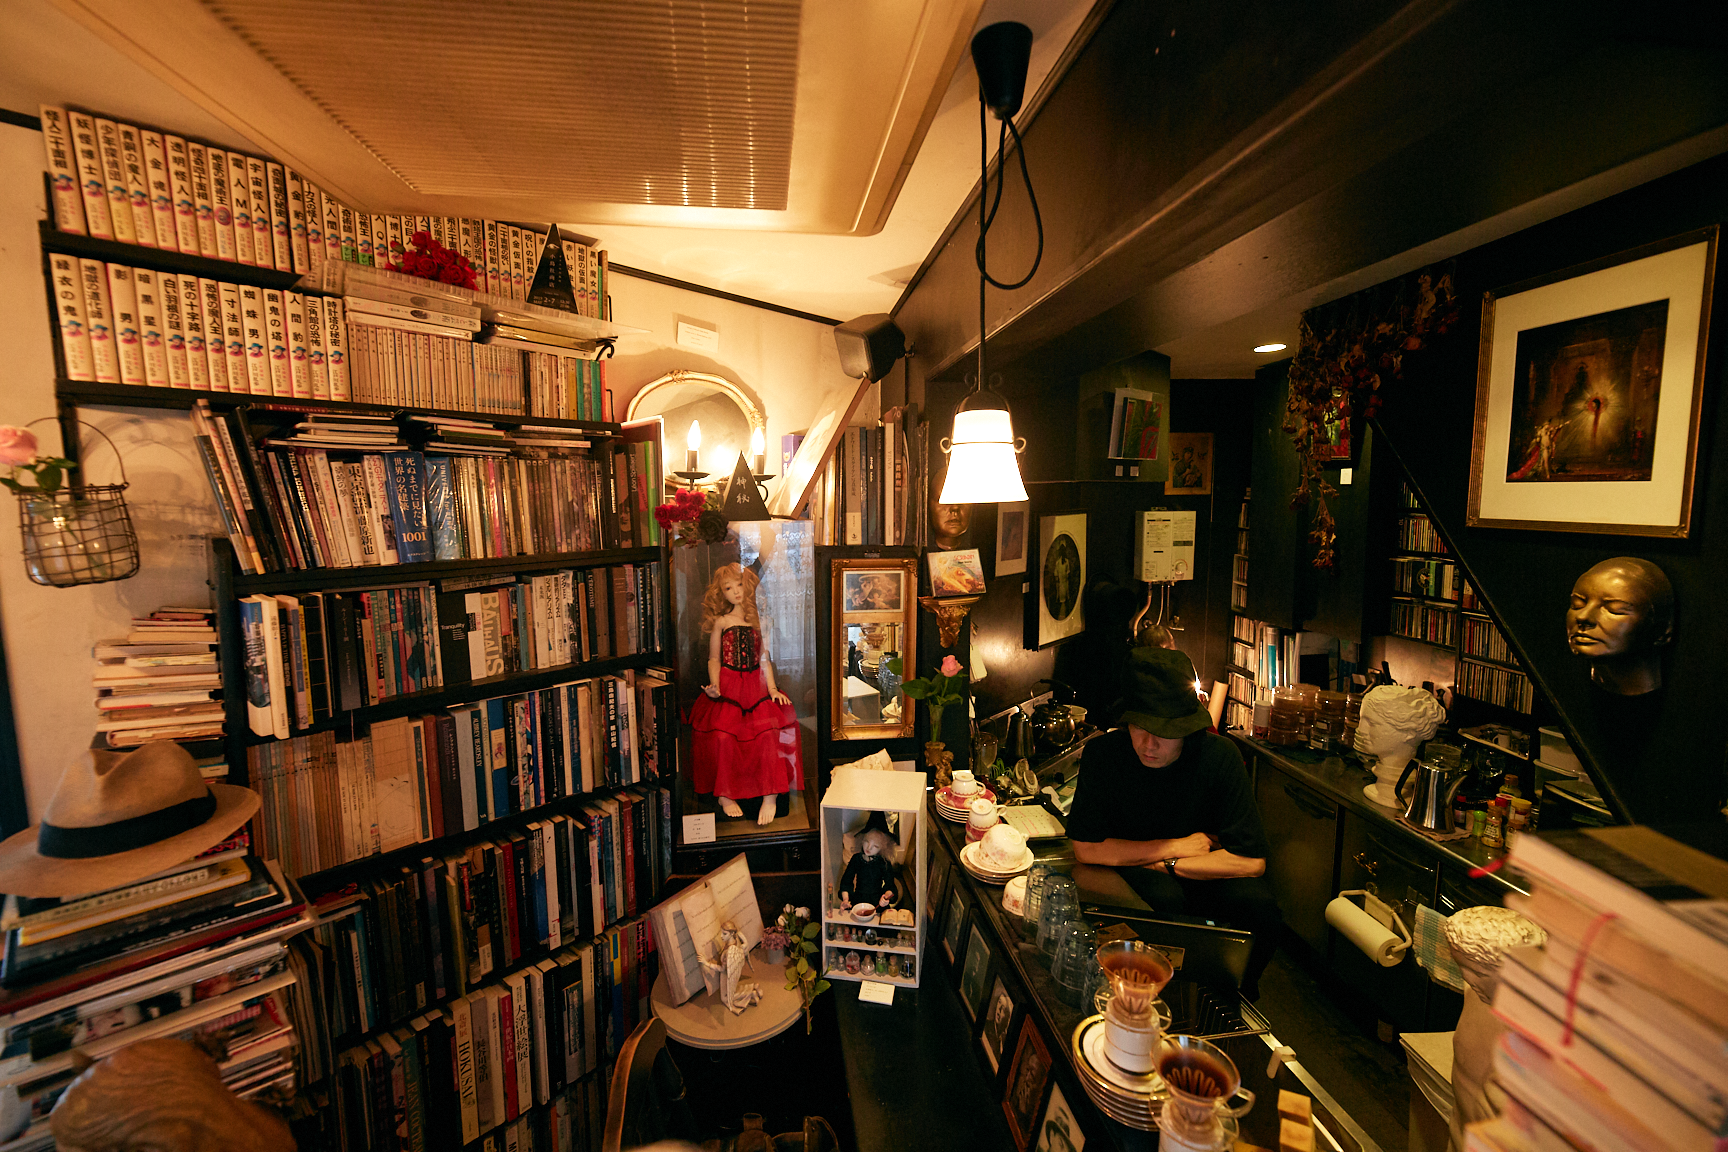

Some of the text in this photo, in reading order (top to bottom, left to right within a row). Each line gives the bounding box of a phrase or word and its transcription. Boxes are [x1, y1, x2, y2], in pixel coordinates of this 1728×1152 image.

[45, 109, 68, 169] 怪人二十面相
[76, 117, 97, 175] 妖怪博士
[122, 130, 142, 186] 青銅の魔人
[145, 136, 166, 192] 大金塊
[171, 141, 189, 196] 透明怪人
[231, 157, 247, 209] 電人M
[250, 162, 265, 214] 宇宙怪人
[289, 170, 304, 220] 黄金豹
[487, 223, 498, 264] 黄金の怪獣
[511, 229, 522, 270] 黄金仮面
[524, 234, 534, 274] 呪いの指紋
[577, 247, 586, 285] 地獄の仮面
[589, 250, 598, 288] 黒い魔女
[55, 259, 78, 317] 緑衣の鬼
[114, 268, 132, 323] 影男
[137, 273, 157, 327] 暗黒星
[183, 280, 201, 332] 死の十字路
[205, 283, 221, 335] 恐怖の魔人王
[223, 288, 240, 337] 一寸法師
[243, 289, 260, 339] 蜘蛛男
[267, 293, 283, 342] 幽鬼の塔
[290, 295, 304, 343] 人間豹
[307, 300, 322, 347] 三角館の恐怖
[327, 301, 341, 347] 時計塔の秘密
[394, 457, 410, 511] 世界の名建築
[404, 457, 423, 527] 死ぬまでに見たい
[736, 476, 750, 504] 神秘
[402, 532, 427, 543] 1001
[482, 596, 504, 676] BAUHAUS
[457, 1039, 474, 1099] HOKUSAI
[410, 1110, 423, 1152] COCTEA
